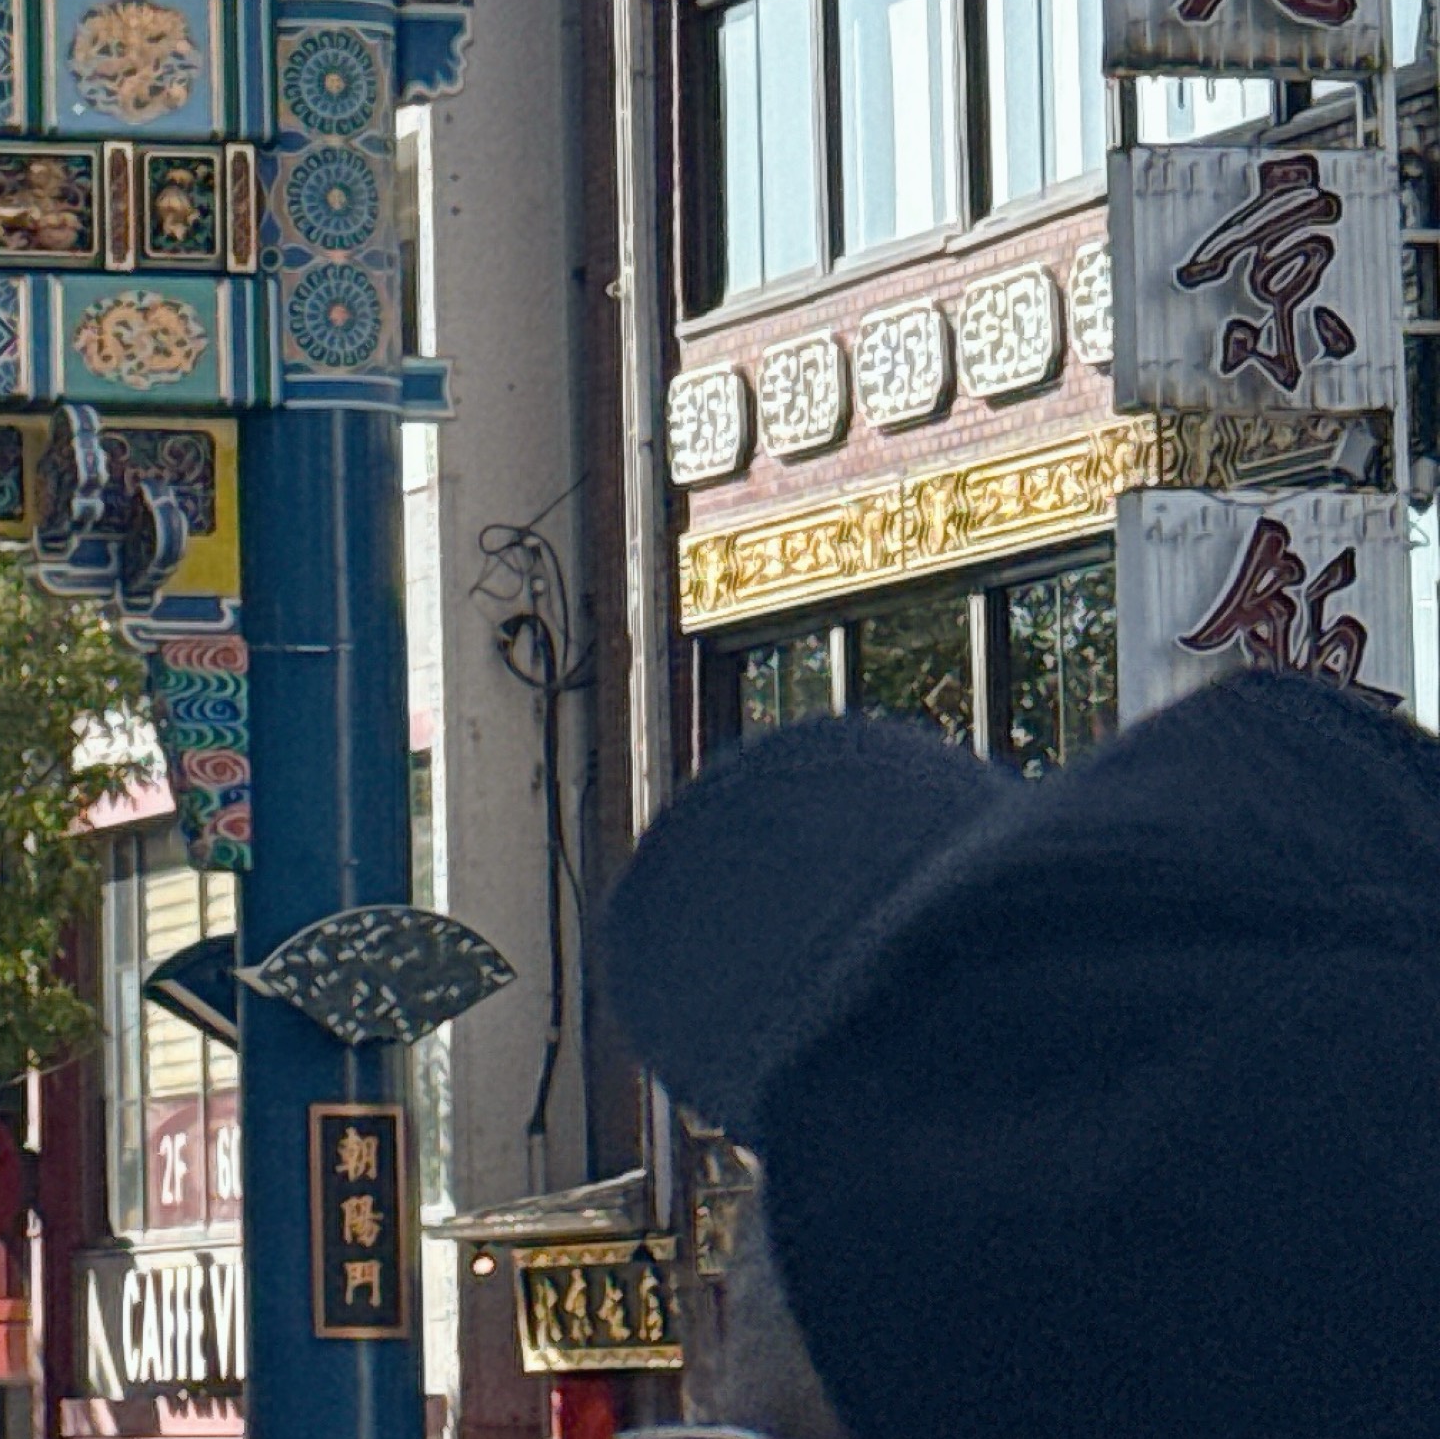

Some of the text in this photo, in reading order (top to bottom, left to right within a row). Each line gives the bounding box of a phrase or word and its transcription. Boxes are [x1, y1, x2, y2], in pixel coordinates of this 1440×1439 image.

[158, 1132, 188, 1204] 2F
[334, 1126, 383, 1308] 朝陽門
[123, 1264, 207, 1382] CAFFE
